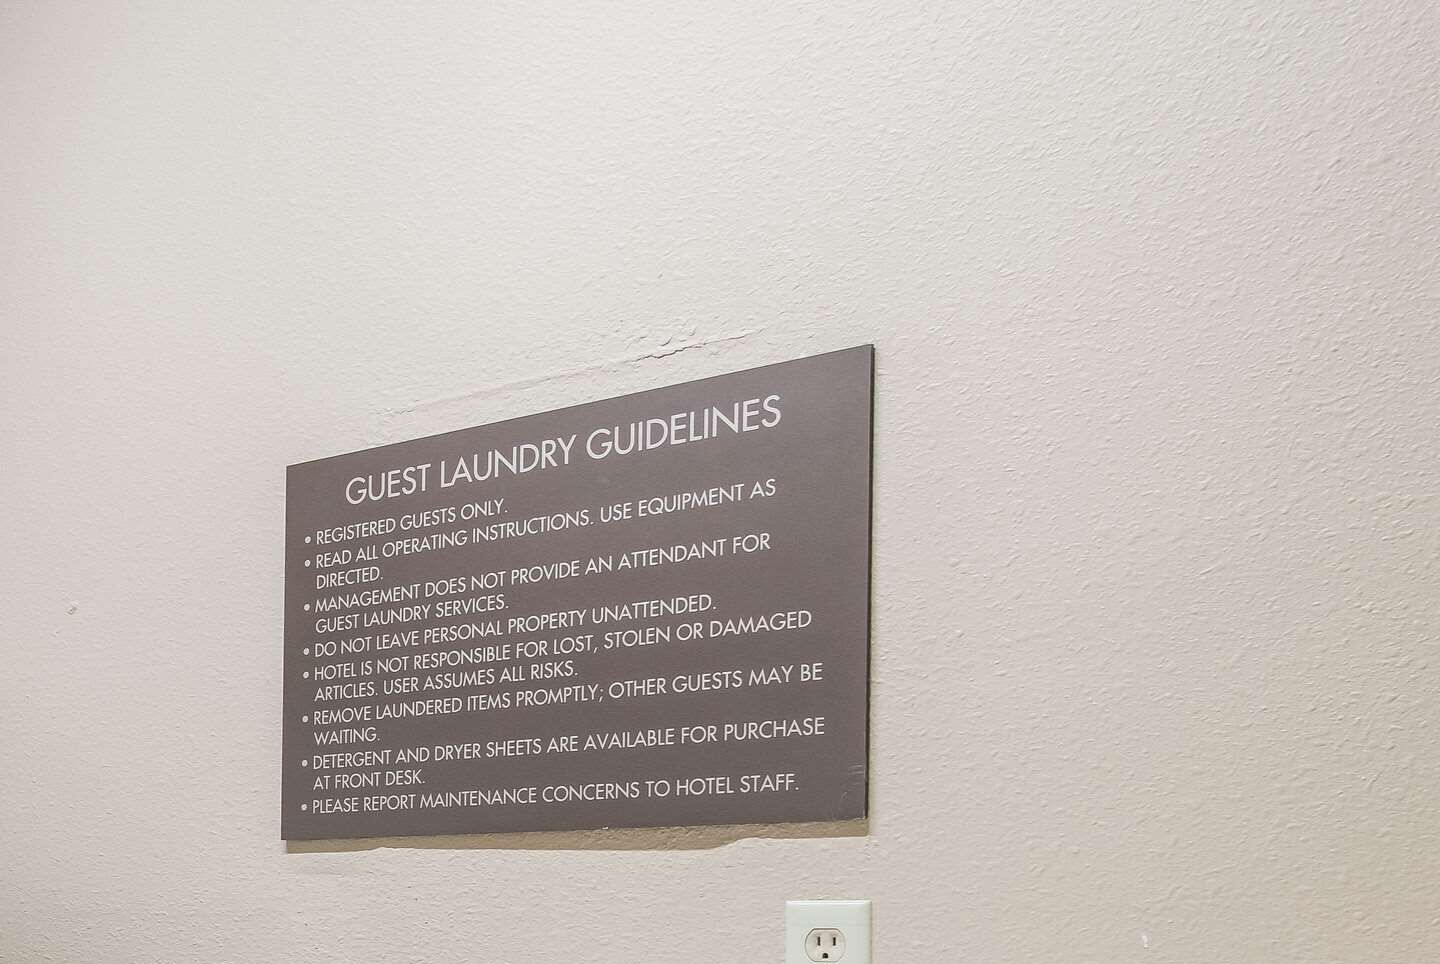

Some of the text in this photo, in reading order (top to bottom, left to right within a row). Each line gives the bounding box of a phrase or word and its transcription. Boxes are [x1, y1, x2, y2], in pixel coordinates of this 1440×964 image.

[345, 394, 782, 505] GUEST LAUNDRY GUIDELINES
[316, 497, 508, 545] REGISTERED GUESTS ONLY.
[316, 478, 776, 569] READ ALL OPERATING INSTRUCTIONS. USE EQUIPMENT AS
[314, 532, 771, 613] MANAGEMENT DOES NOT PROVIDE AN ATTENDANT FOR
[316, 566, 384, 590] DIRECTED.
[314, 594, 717, 658] DO NOT LEAVE PERSONAL PROPERTY UNATTENDED.
[315, 593, 509, 634] GUEST LAUNDRY SERVICES.
[314, 610, 812, 681] HOTEL IS NOT RESPONSIBLE FOR LOST, STOLEN OR DAMAGED
[313, 662, 823, 726] REMOVE LAUNDERED ITEMS PROMPTLY; OTHER GUESTS MAY BE
[314, 660, 578, 702] ARTICLES. USER ASSUMES ALL RISKS.
[313, 726, 381, 746] WAITING.
[313, 716, 825, 770] DETERGENT AND DRYER SHEETS ARE AVAILABLE FOR PURCHASE
[312, 773, 799, 814] PLEASE REPORT MAINTENANCE CONCERNS TO HOTEL STAFF.
[313, 768, 426, 791] AT FRONT DESK.
